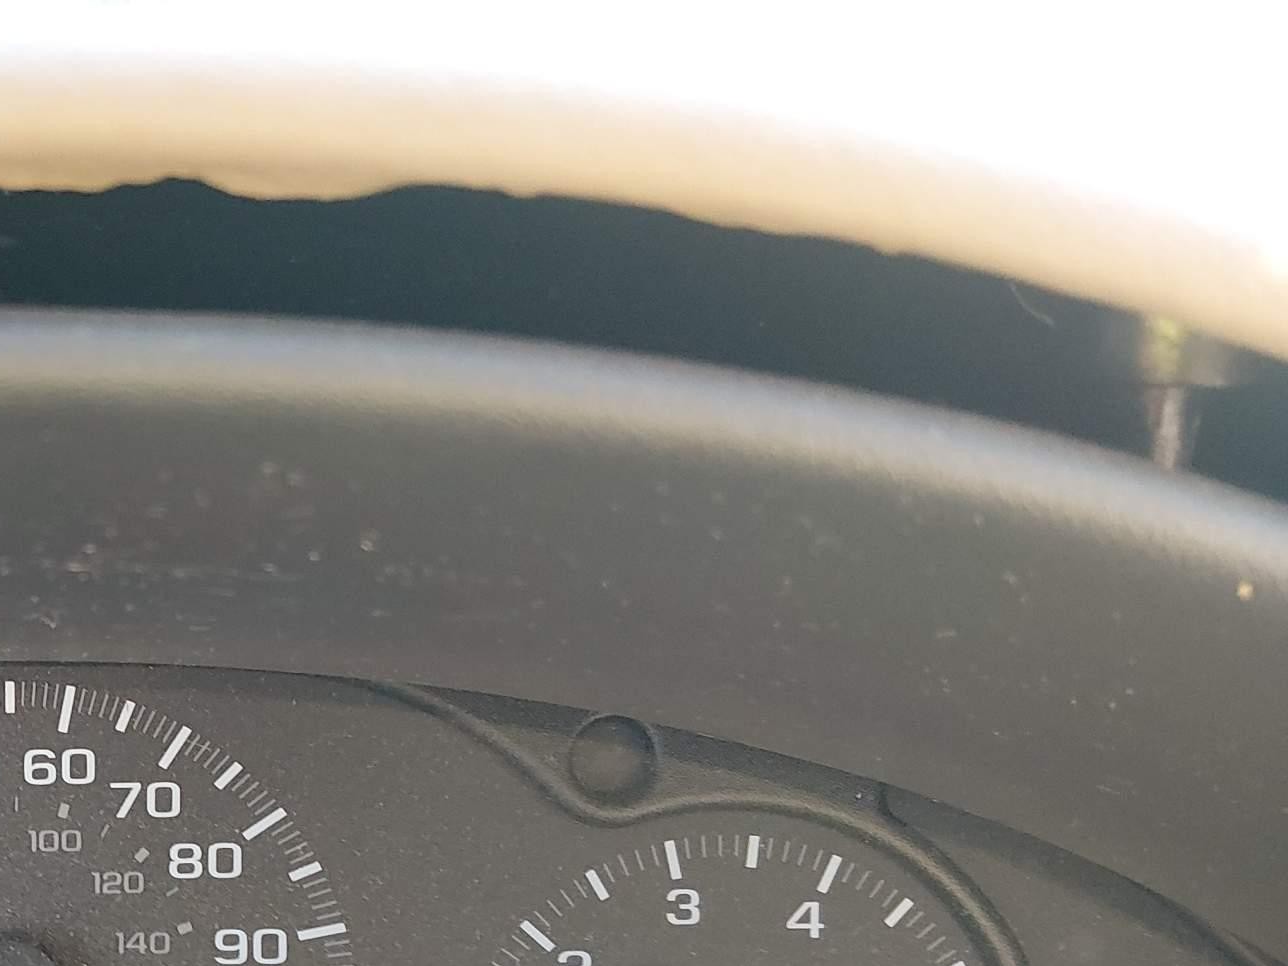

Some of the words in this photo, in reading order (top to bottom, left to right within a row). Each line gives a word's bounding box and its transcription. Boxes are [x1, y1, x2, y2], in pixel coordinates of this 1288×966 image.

[23, 748, 96, 785] 60
[110, 781, 181, 818] 70
[28, 831, 82, 852] 100
[169, 843, 243, 879] 80
[92, 872, 144, 894] 120
[666, 890, 700, 926] 3
[787, 901, 824, 939] 4
[116, 932, 170, 954] 140
[214, 929, 288, 965] 90
